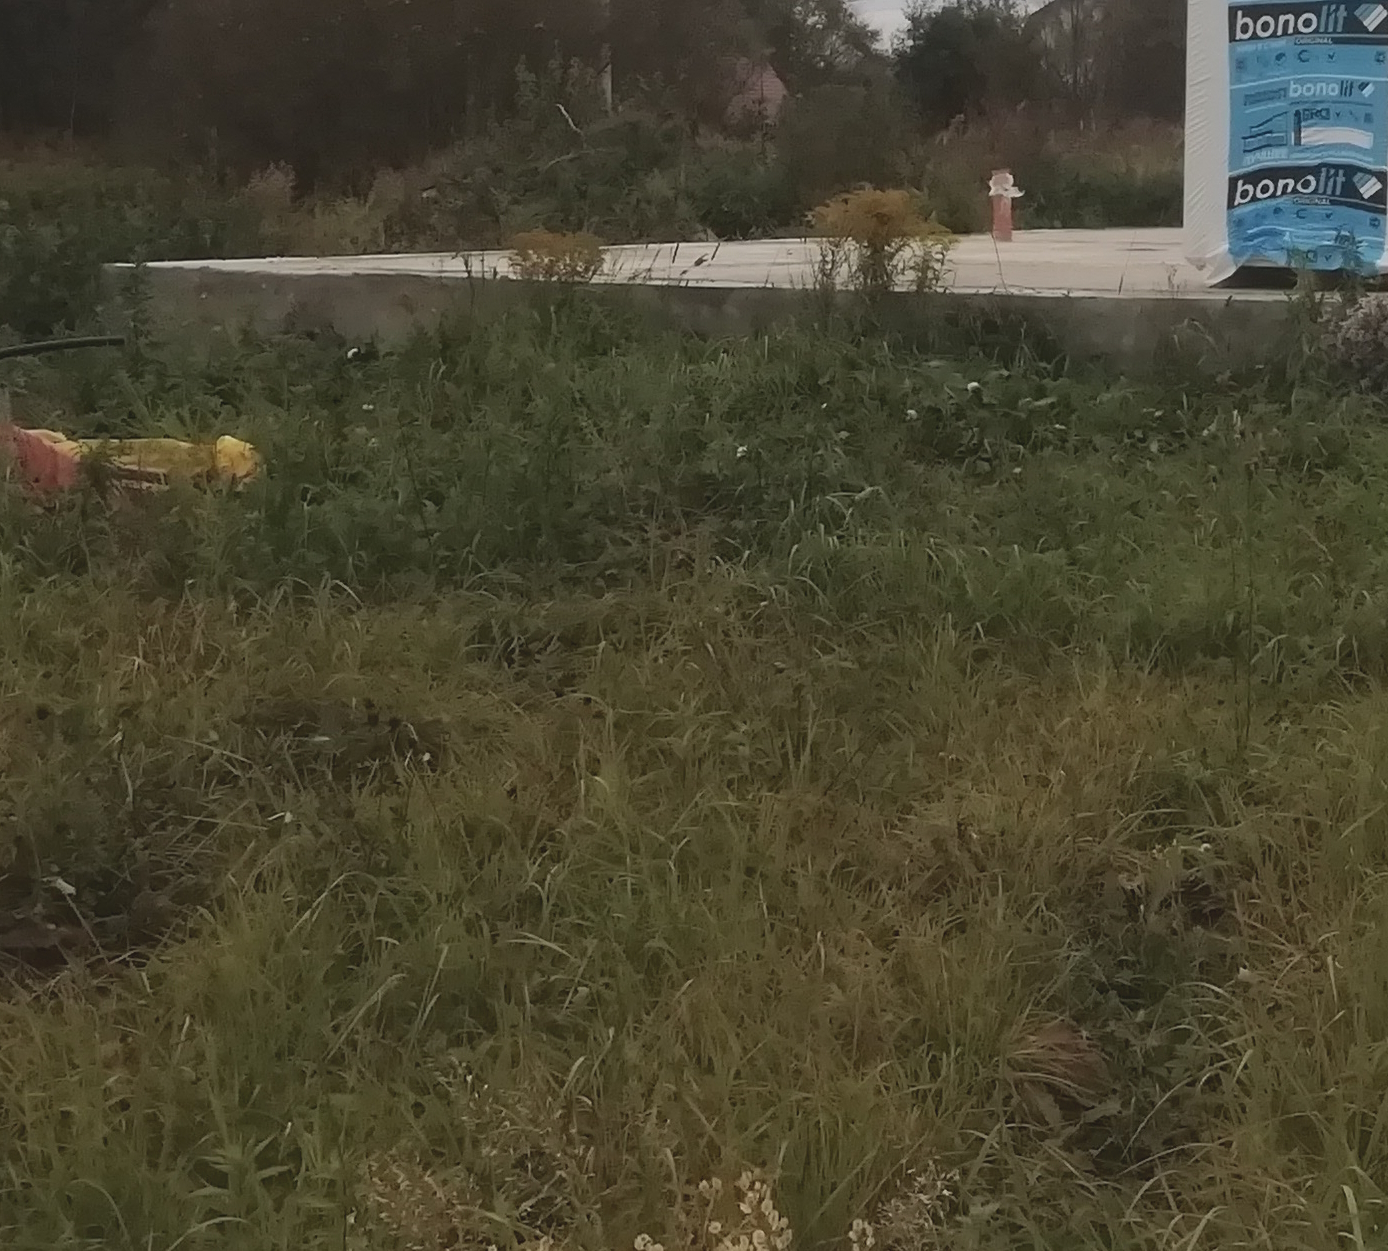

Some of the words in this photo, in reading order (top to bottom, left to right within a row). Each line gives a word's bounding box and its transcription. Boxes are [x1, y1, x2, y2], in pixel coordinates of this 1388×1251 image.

[1235, 4, 1347, 40] bonolit
[1289, 80, 1354, 98] bonolit
[1233, 167, 1346, 206] bonolit
